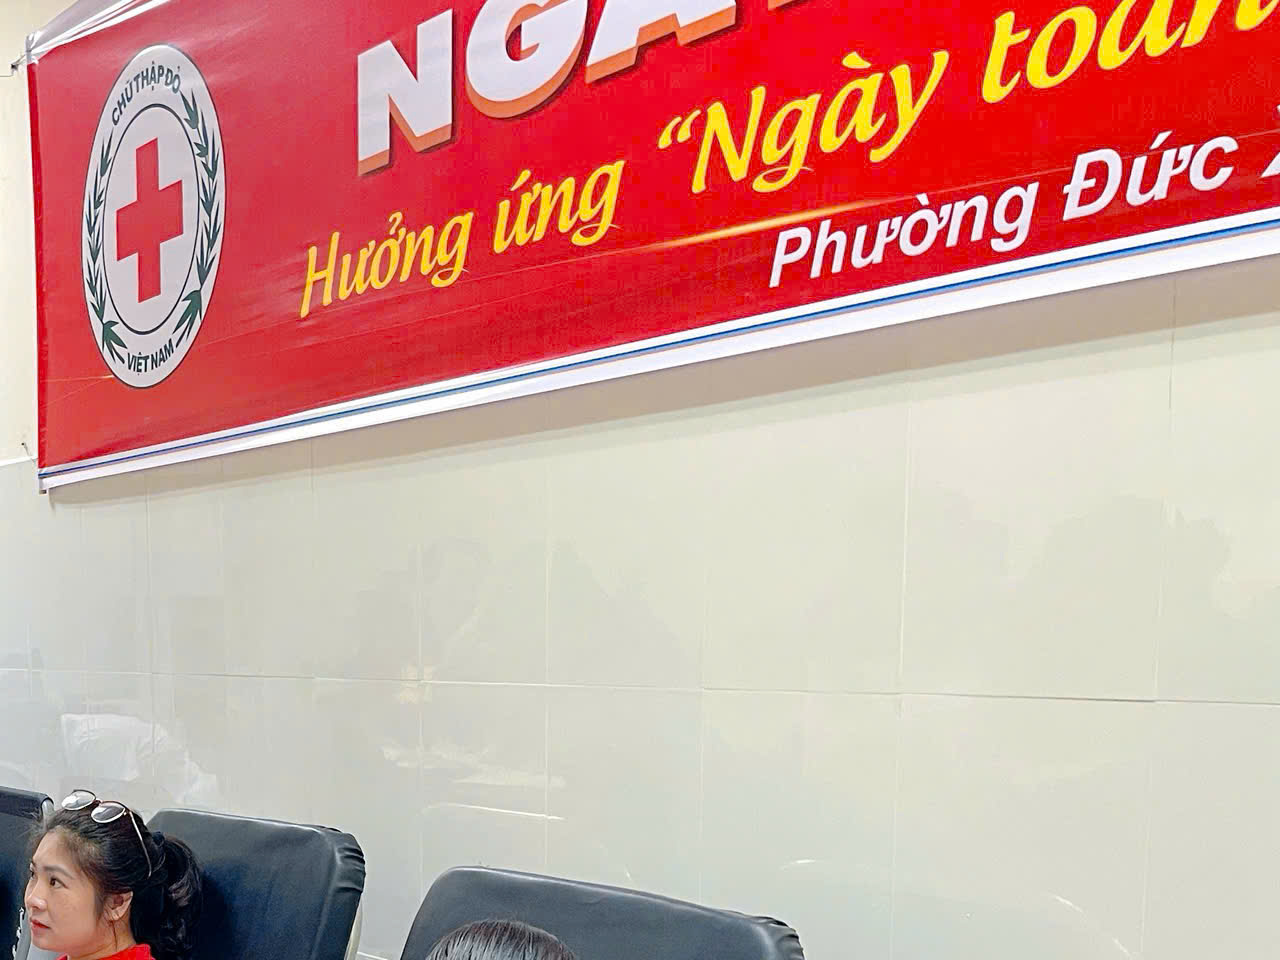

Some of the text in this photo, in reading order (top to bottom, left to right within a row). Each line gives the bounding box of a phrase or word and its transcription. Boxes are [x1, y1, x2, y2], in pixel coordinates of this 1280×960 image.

[299, 211, 473, 319] Hưởng
[493, 160, 627, 254] ứng
[768, 182, 1040, 288] Phường
[1062, 131, 1239, 221] Đức
[127, 338, 174, 376] VIỆT NAM
